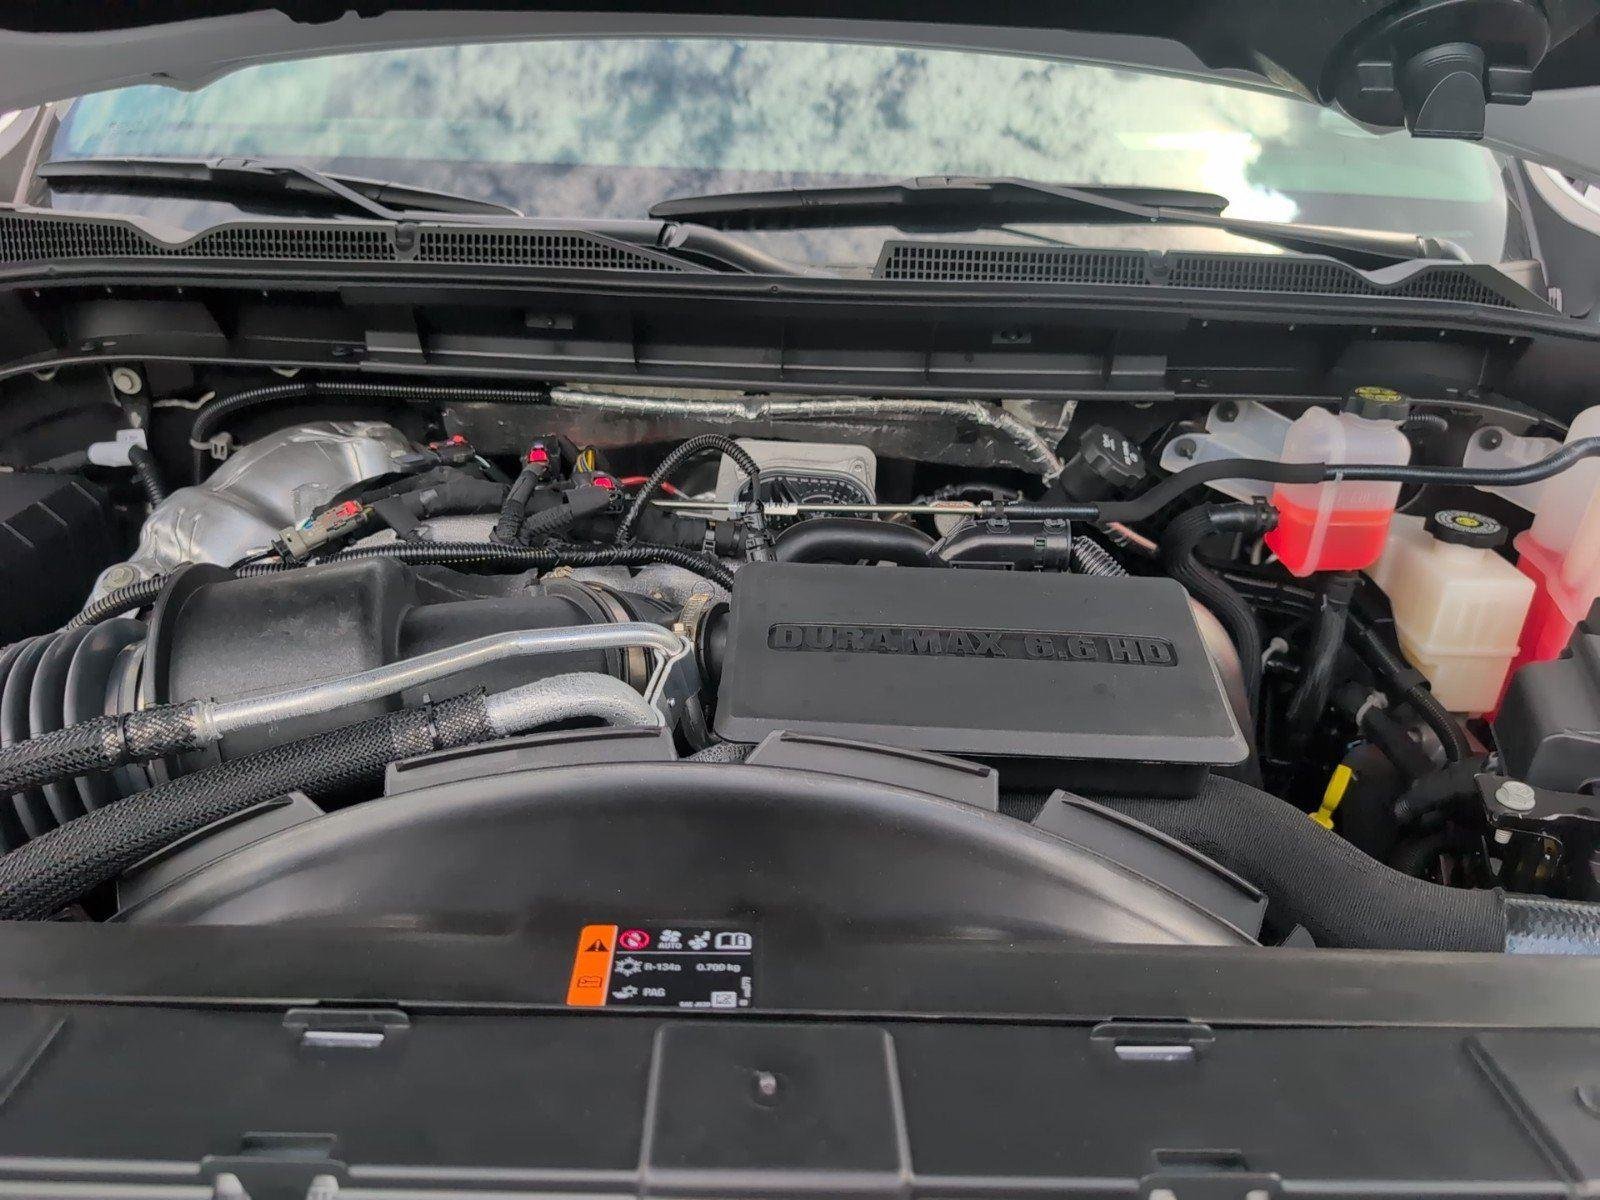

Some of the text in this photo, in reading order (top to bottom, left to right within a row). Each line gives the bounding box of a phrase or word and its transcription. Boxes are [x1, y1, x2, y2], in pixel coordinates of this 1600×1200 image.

[773, 626, 1173, 666] DURAMAX 6.6 HD
[643, 962, 682, 972] R-134a
[642, 987, 666, 998] PAG
